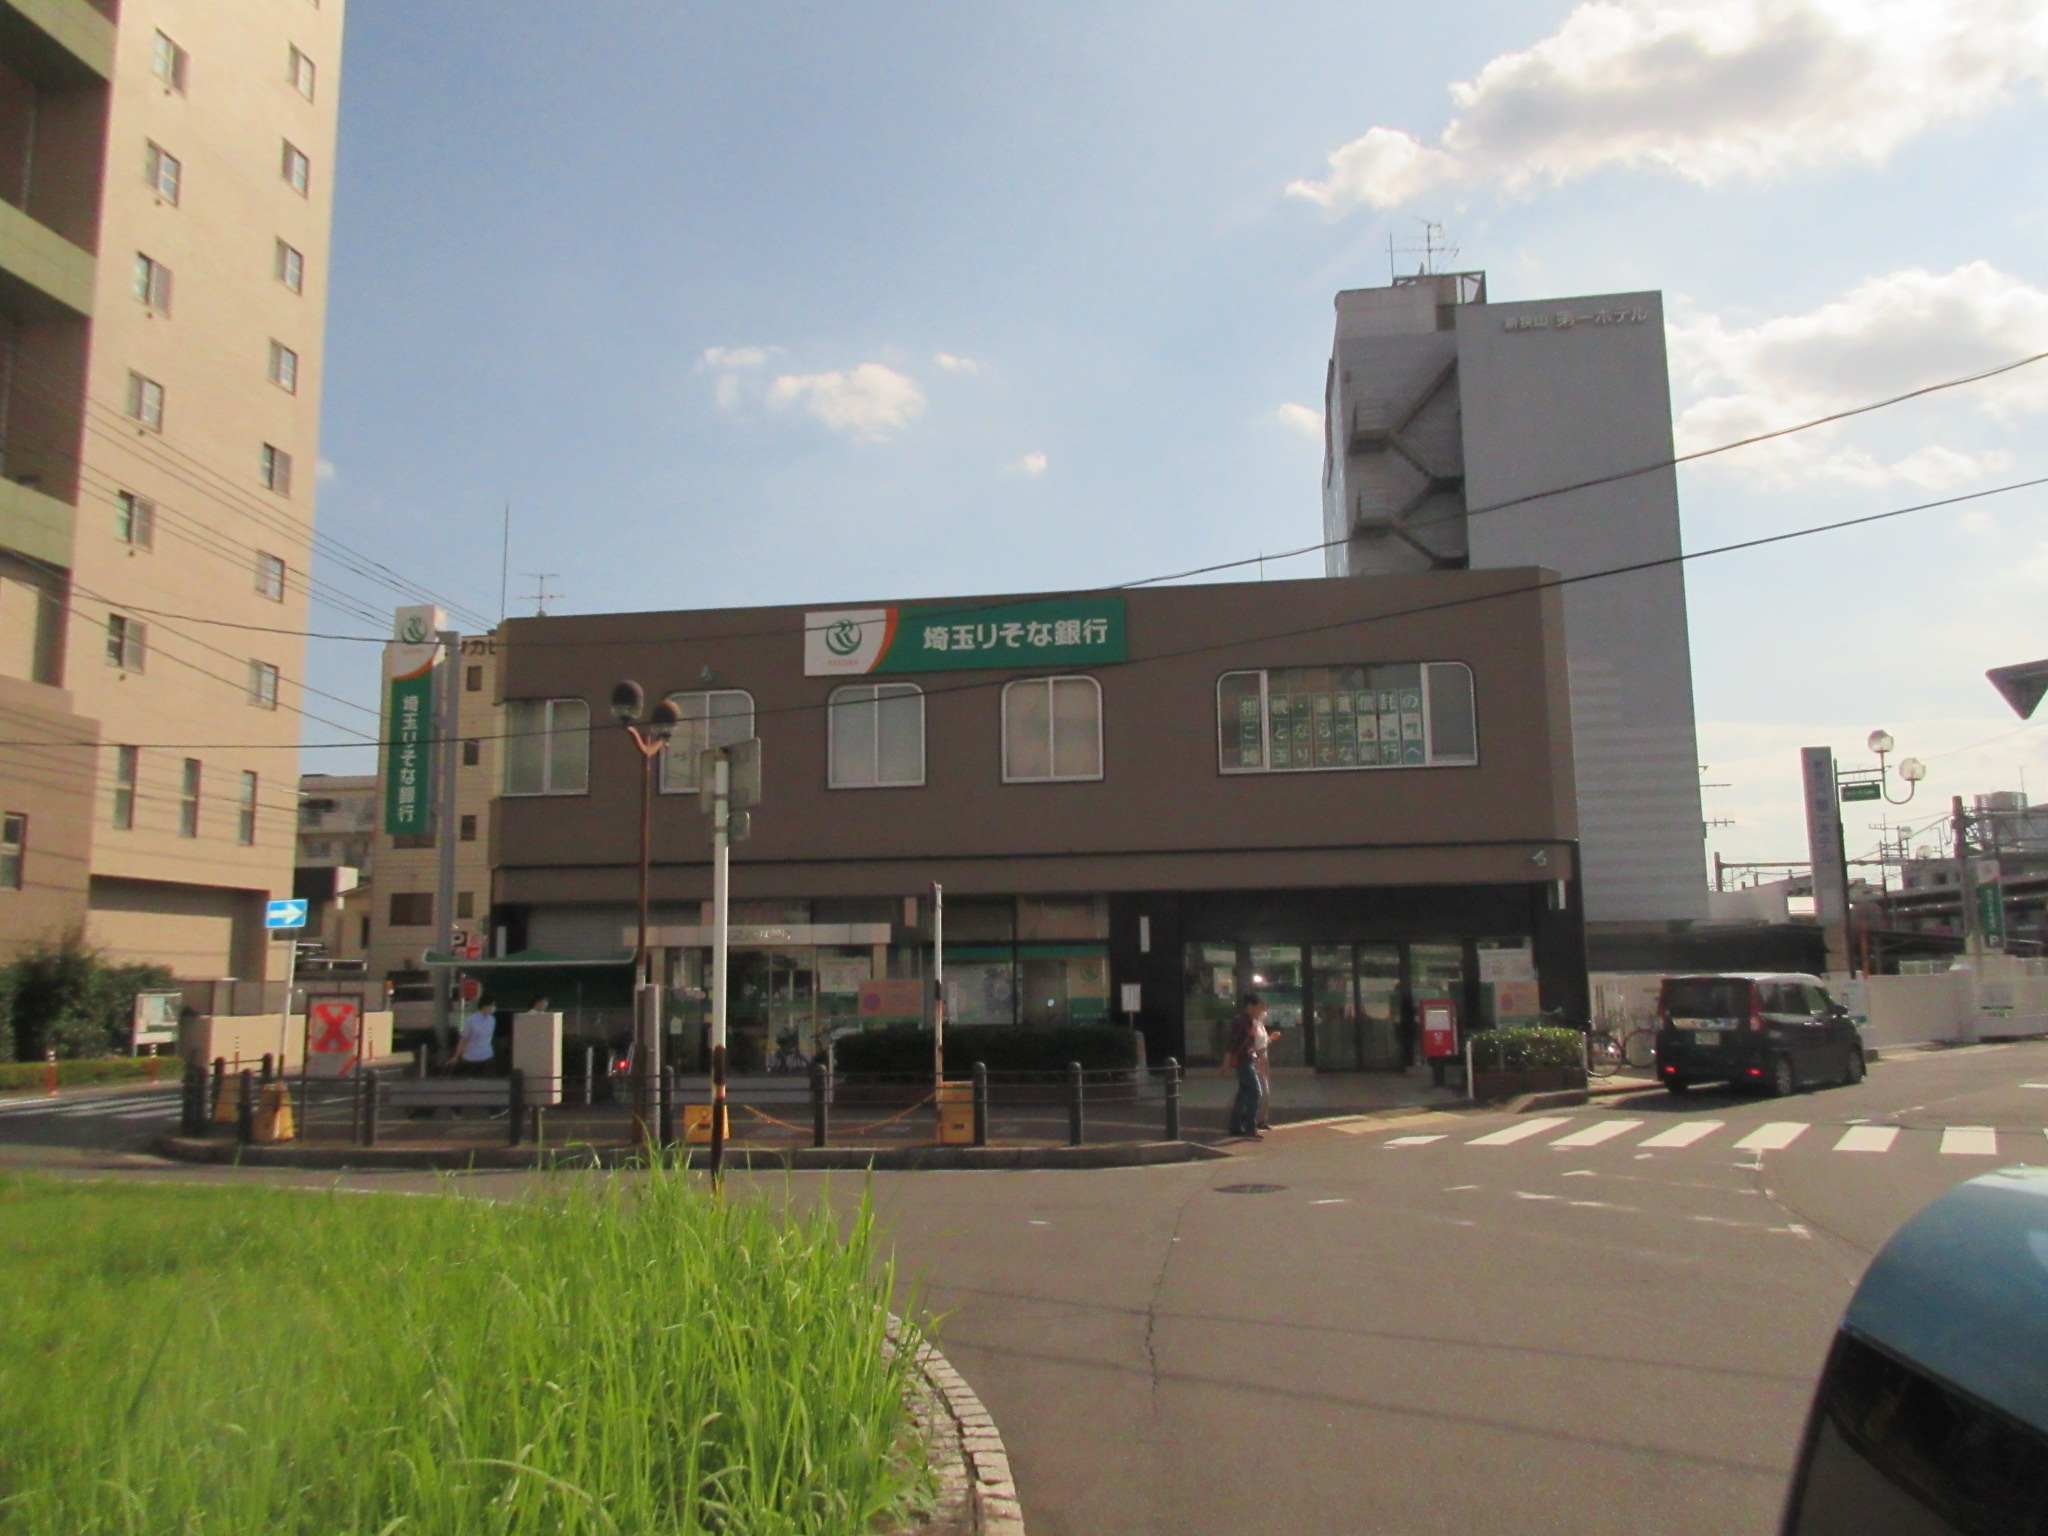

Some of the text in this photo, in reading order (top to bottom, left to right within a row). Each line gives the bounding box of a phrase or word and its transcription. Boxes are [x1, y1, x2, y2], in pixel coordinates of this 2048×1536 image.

[1556, 306, 1648, 328] 第一ホテル
[923, 618, 1108, 651] 埼玉りそな銀行
[399, 695, 419, 823] 埼玉りそな銀行
